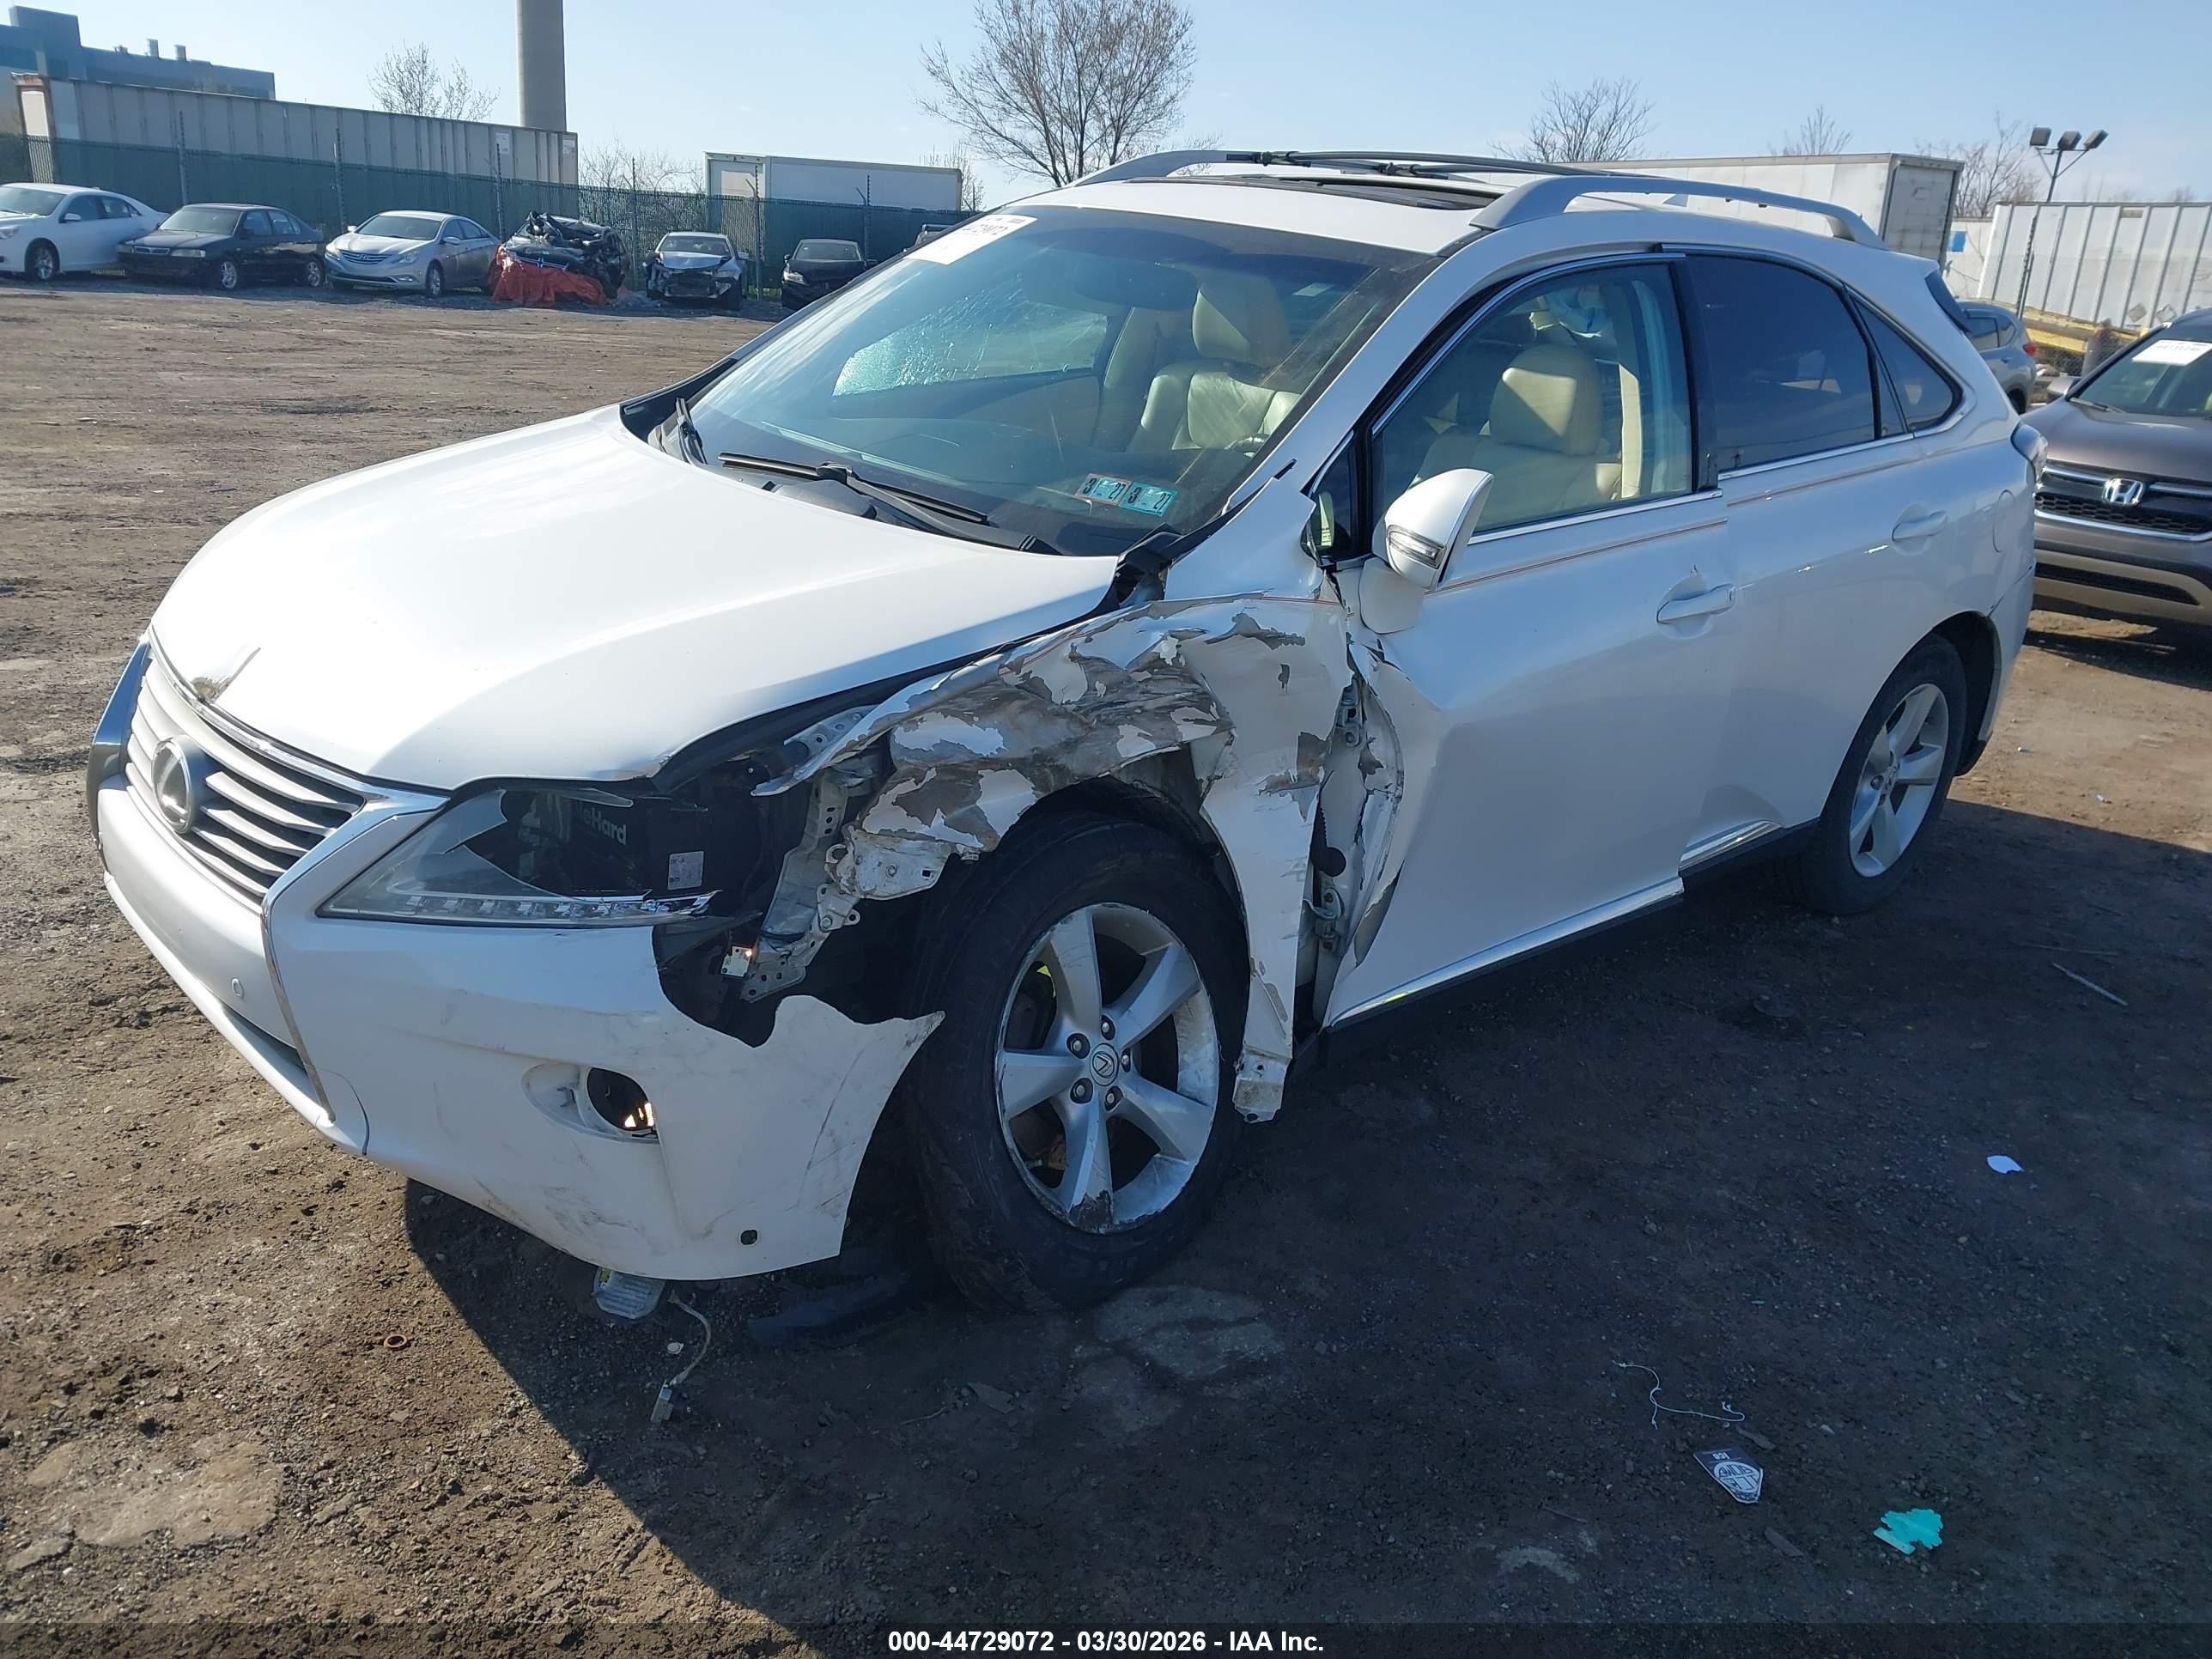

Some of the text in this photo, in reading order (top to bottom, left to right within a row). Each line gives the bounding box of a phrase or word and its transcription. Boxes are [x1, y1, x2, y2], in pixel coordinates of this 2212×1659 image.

[1083, 478, 1126, 501] 3 27
[1127, 487, 1171, 510] 3 27
